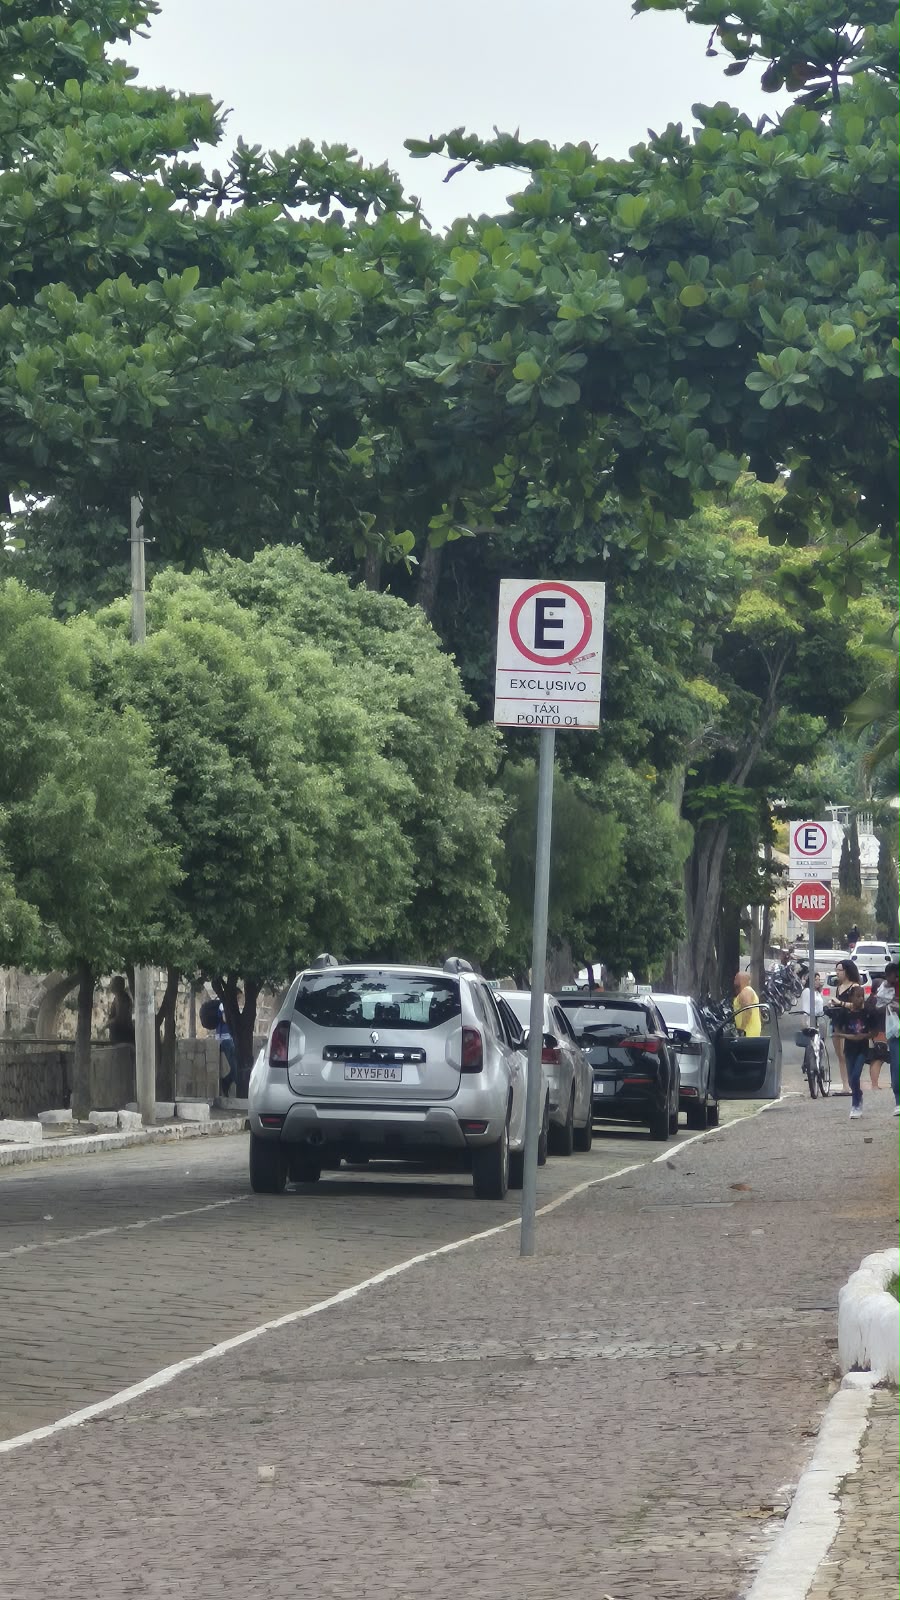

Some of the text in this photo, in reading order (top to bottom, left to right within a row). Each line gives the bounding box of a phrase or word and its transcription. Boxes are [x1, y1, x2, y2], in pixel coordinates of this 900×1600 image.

[534, 597, 566, 650] E
[510, 678, 587, 692] EXCLUSIVO
[533, 702, 559, 714] TÁXI
[517, 714, 580, 726] PONTO 01
[804, 828, 818, 849] E
[795, 894, 826, 909] PARE
